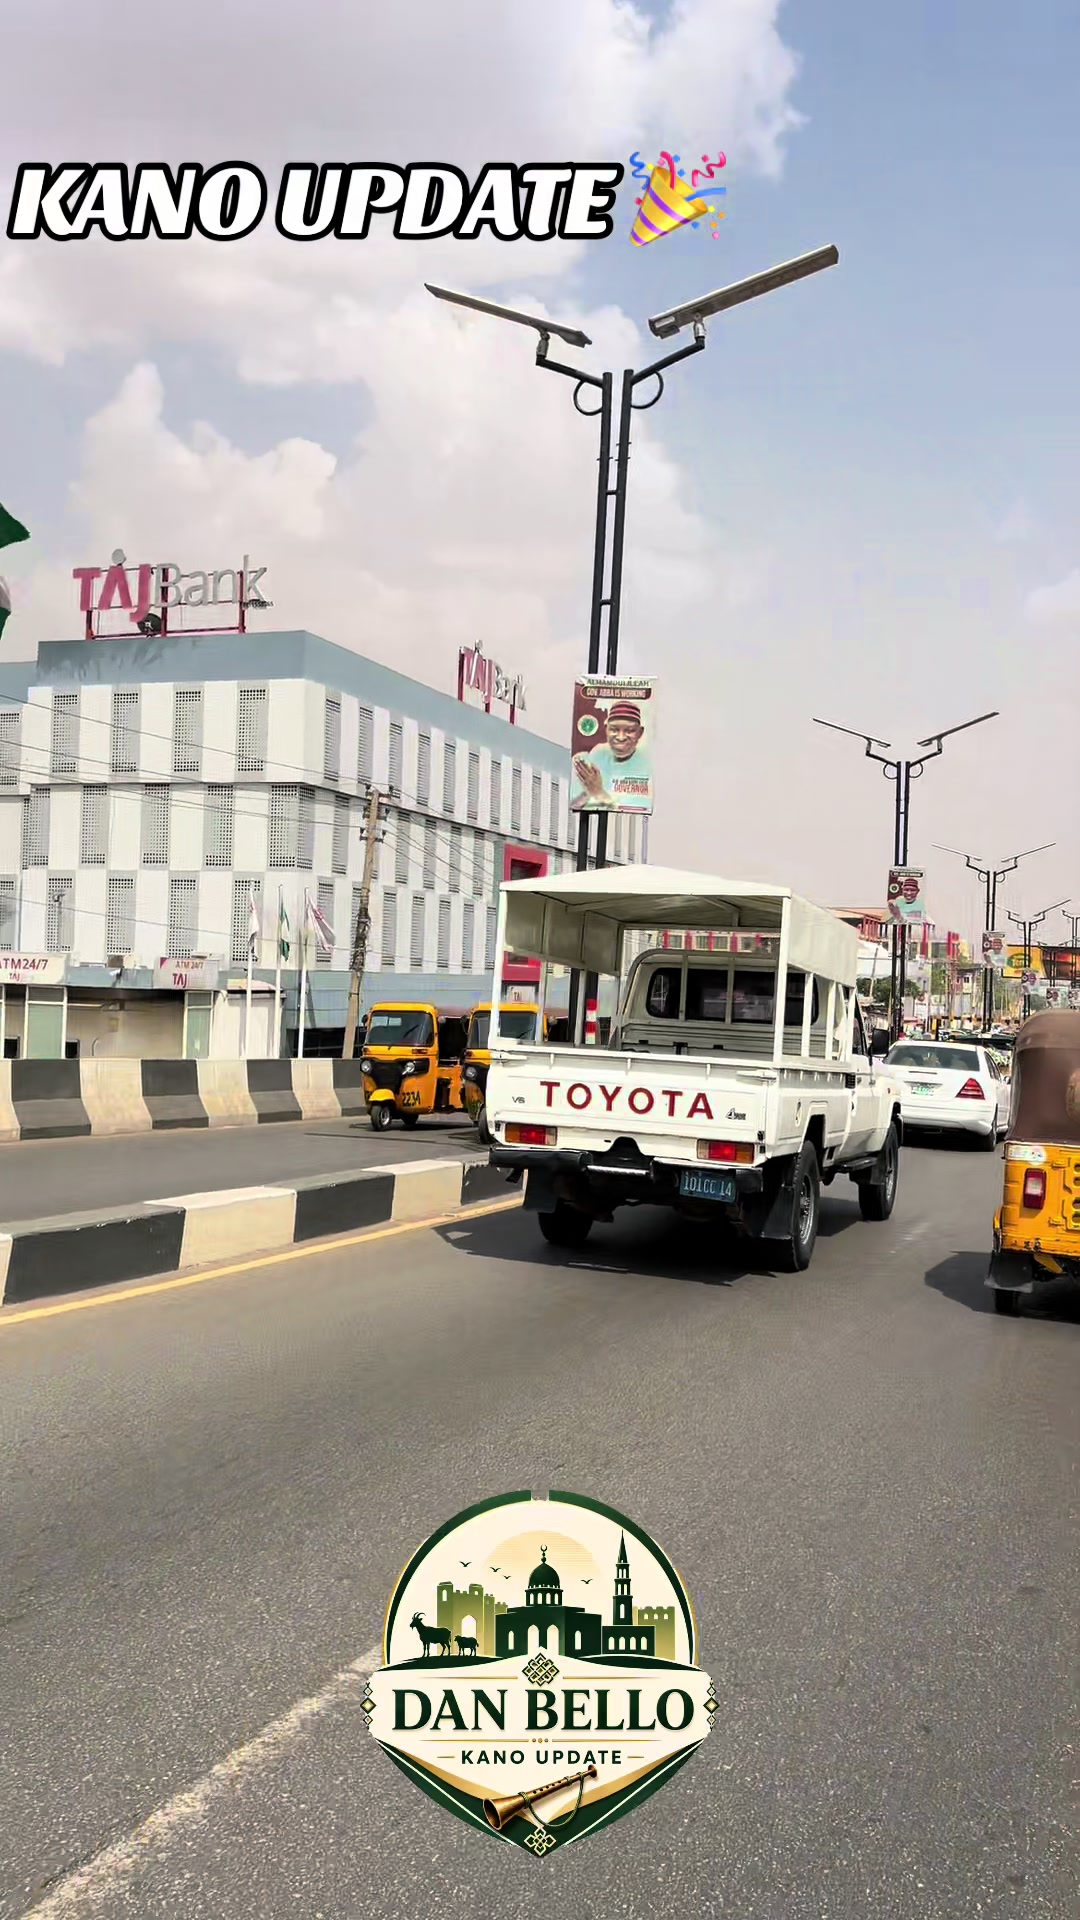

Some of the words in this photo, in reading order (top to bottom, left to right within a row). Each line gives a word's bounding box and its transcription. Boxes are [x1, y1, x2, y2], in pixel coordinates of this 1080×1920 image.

[621, 689, 646, 698] WORKING
[176, 961, 189, 969] ATM
[172, 973, 187, 988] TAJ
[540, 1080, 714, 1120] TOYOTA
